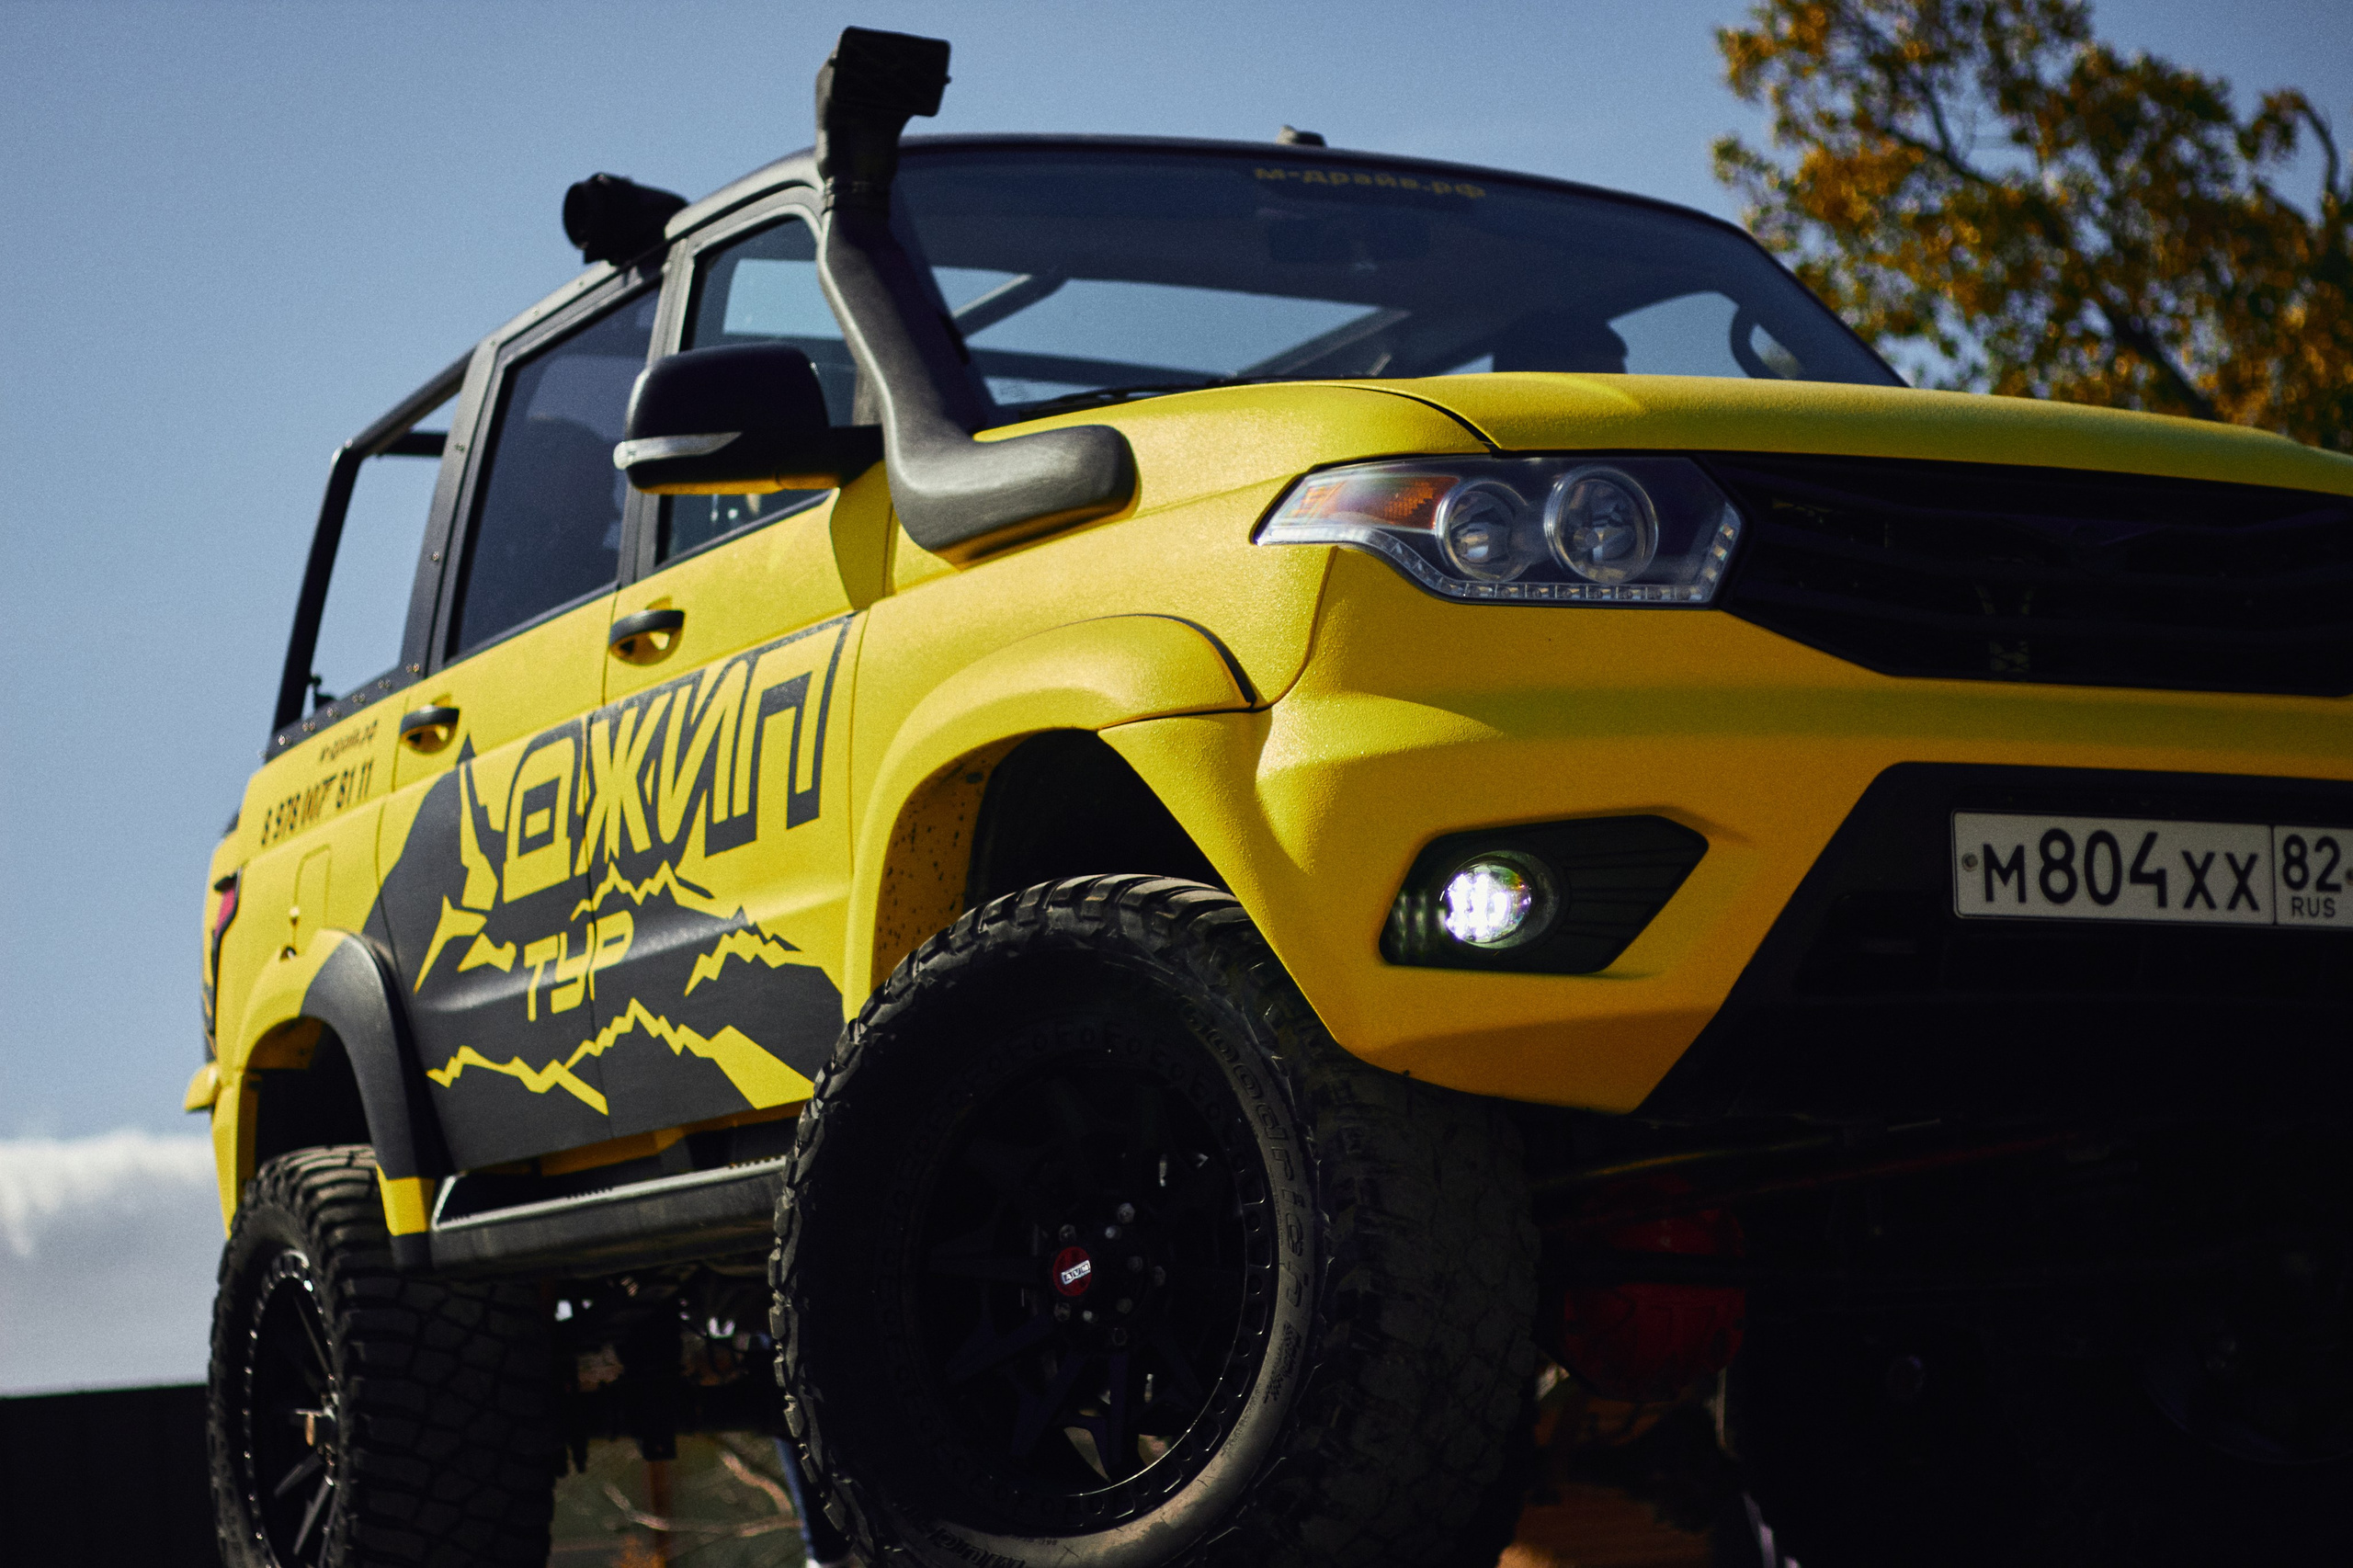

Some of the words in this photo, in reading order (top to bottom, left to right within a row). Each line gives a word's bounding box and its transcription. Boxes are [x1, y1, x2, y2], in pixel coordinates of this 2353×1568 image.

[502, 618, 849, 903] ДЖИП
[1983, 827, 2261, 912] М804ХХ
[2282, 834, 2343, 893] 82
[2290, 896, 2336, 918] RUS
[524, 910, 635, 1021] ТУР
